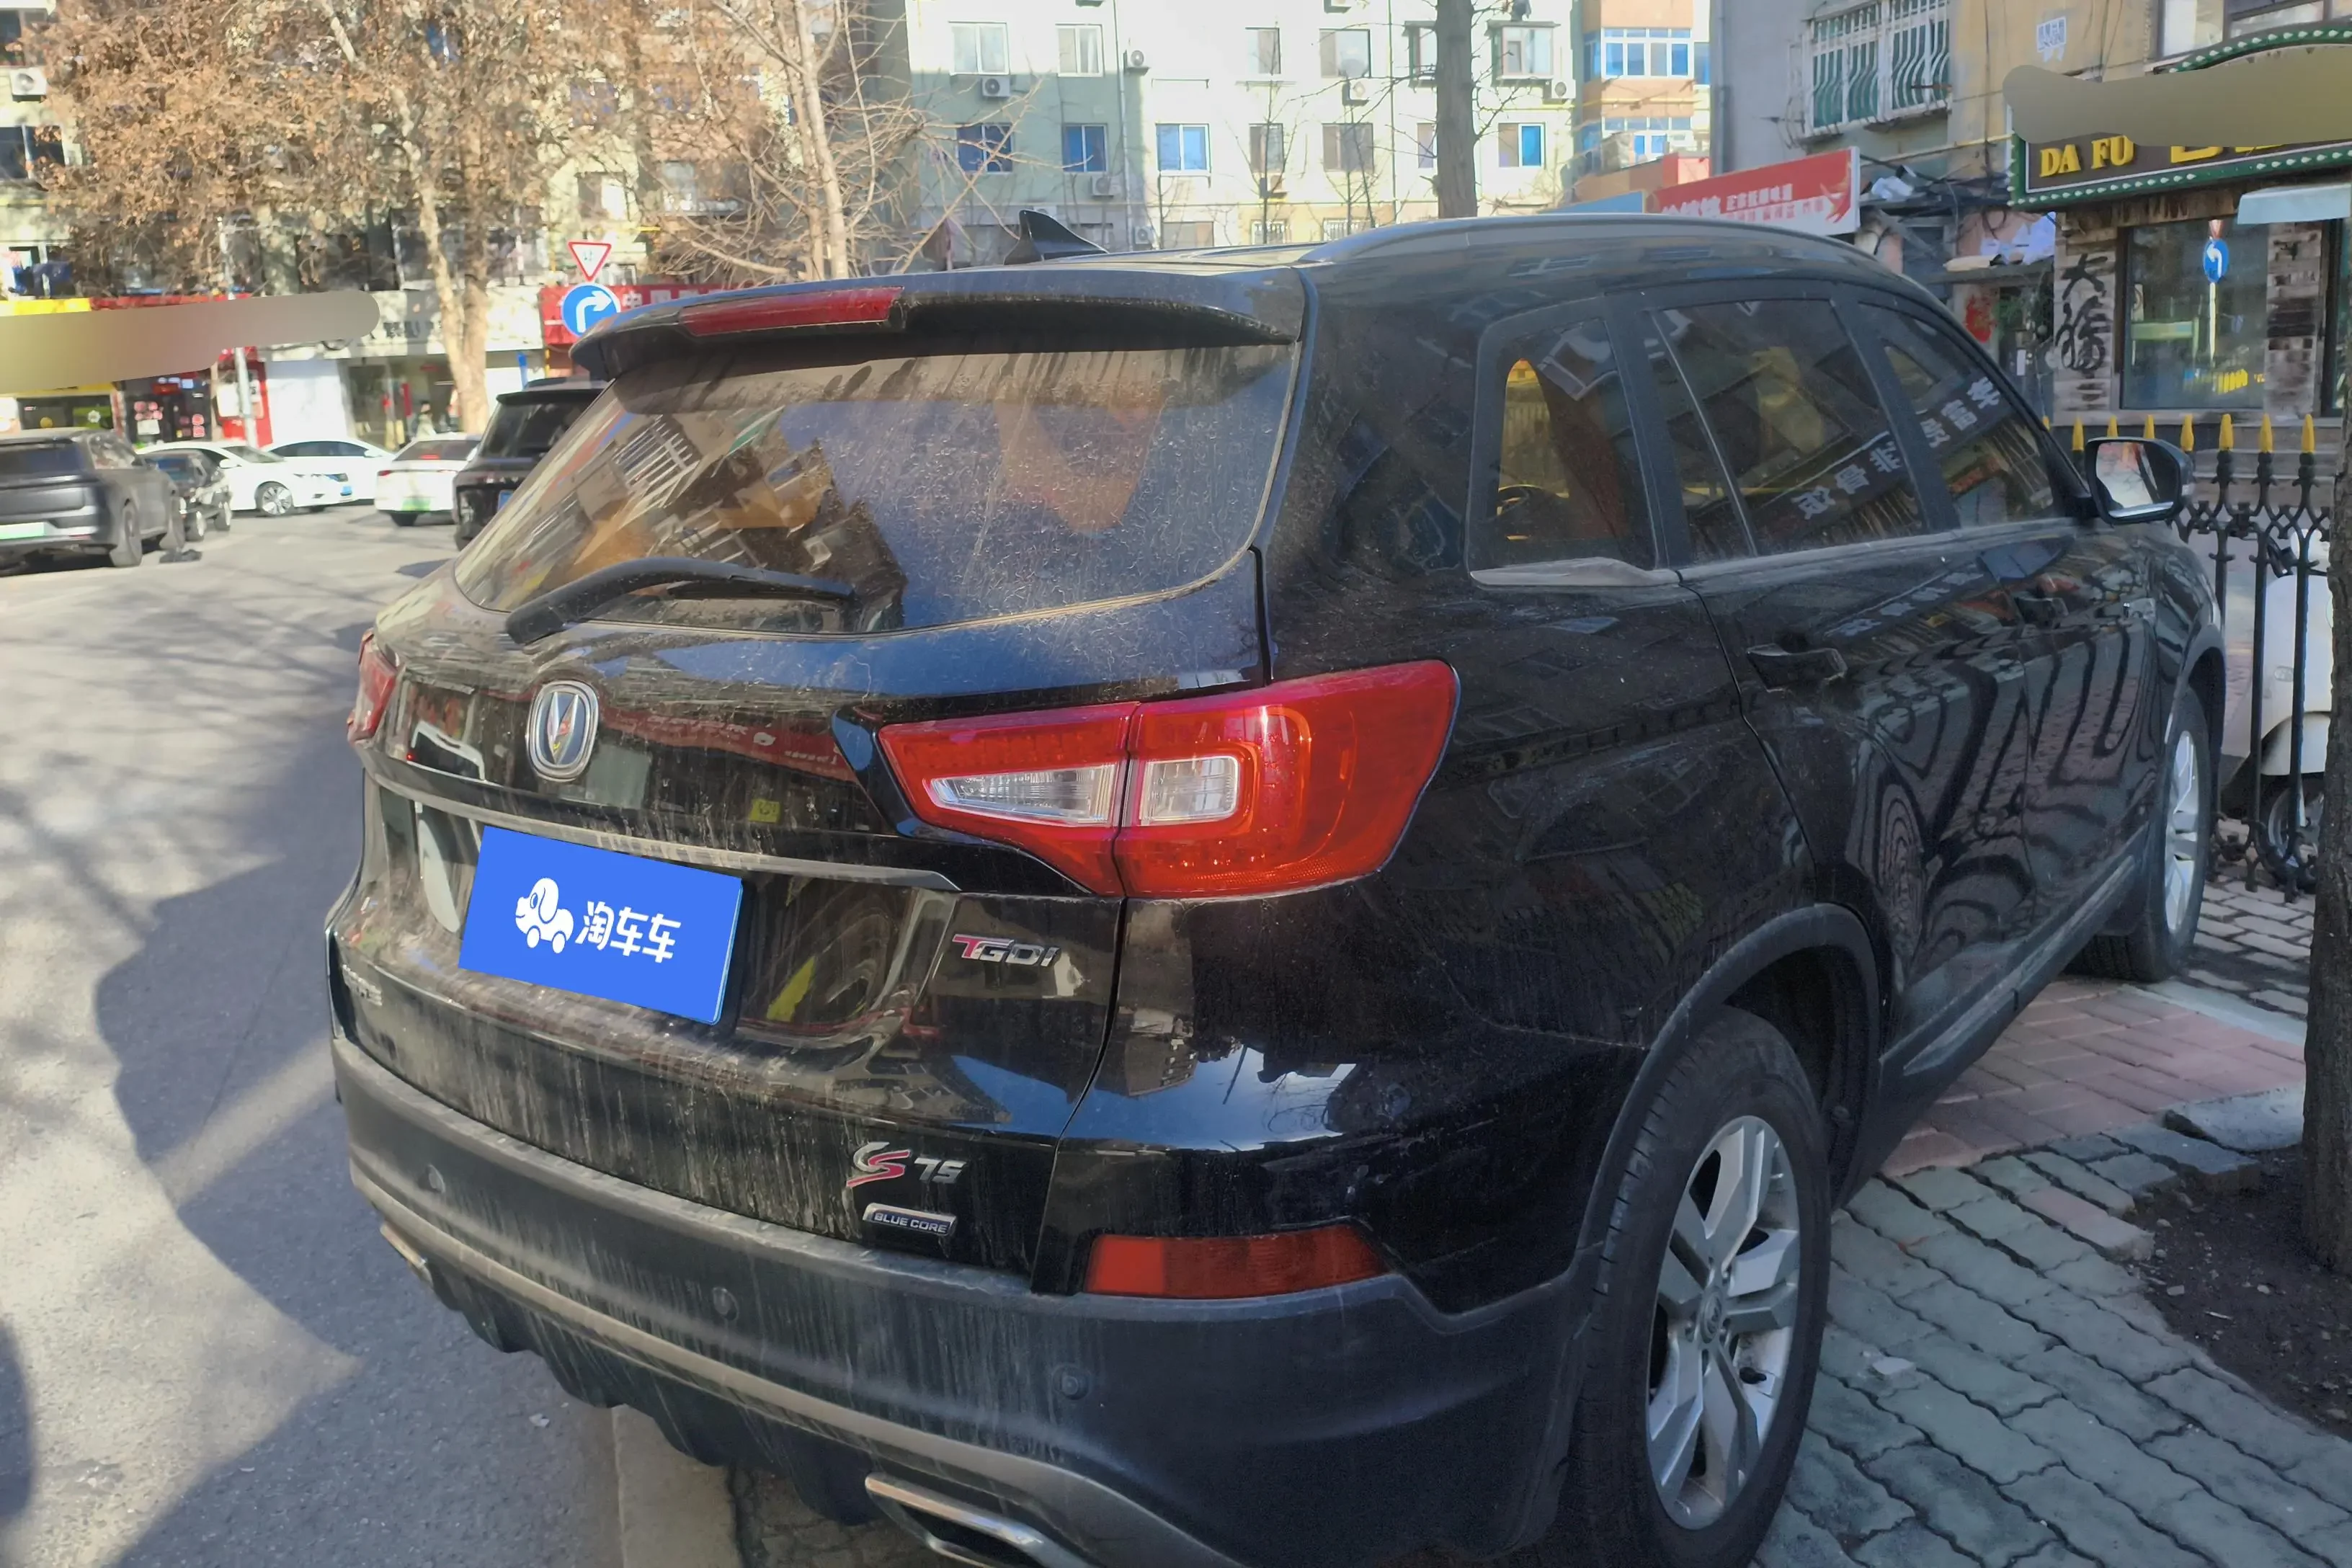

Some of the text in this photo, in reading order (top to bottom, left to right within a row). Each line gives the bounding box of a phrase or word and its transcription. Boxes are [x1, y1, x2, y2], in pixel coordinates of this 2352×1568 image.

[2039, 144, 2082, 177] DA
[2091, 135, 2135, 169] FU
[873, 1212, 948, 1234] BLUE CORE
